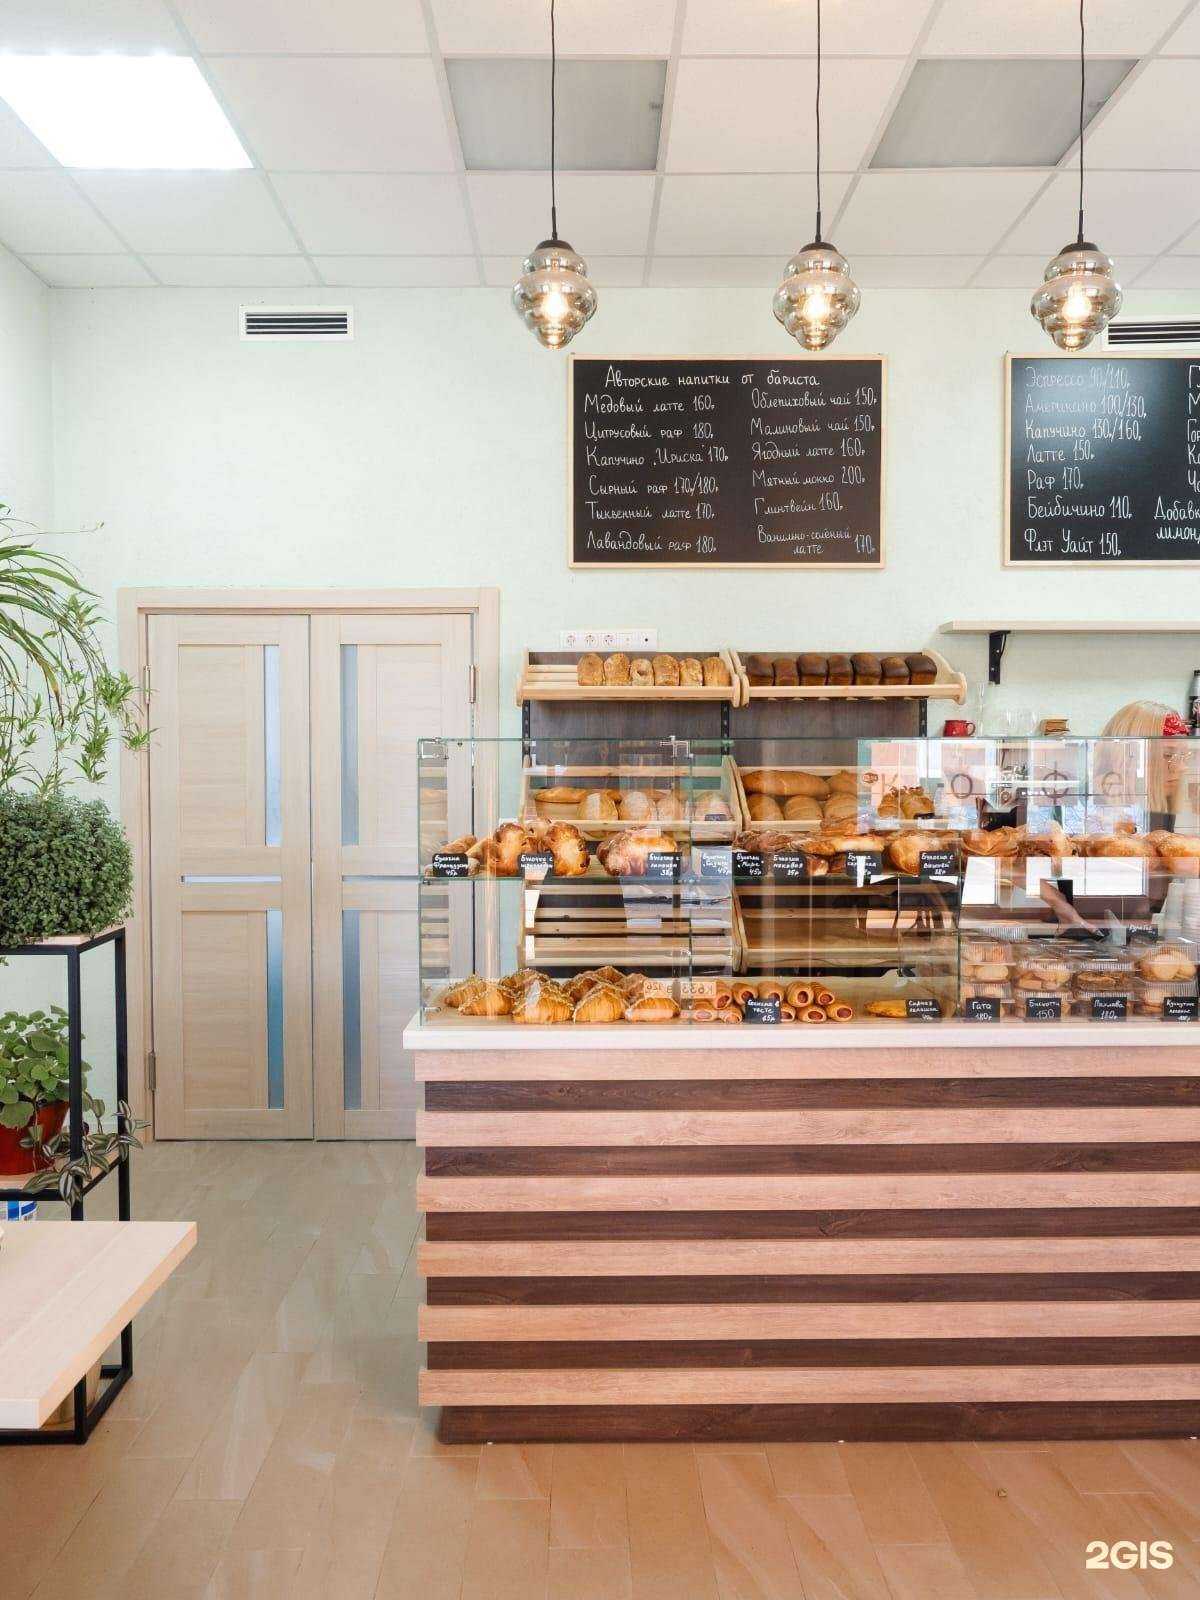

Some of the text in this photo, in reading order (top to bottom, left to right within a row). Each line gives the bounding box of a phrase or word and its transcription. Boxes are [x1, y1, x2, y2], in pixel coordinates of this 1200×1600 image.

[605, 364, 820, 388] Авторские напитки от бариста
[584, 393, 644, 413] Медовый
[653, 402, 685, 412] латте
[752, 388, 826, 409] Облепиховый
[830, 392, 851, 405] чай
[584, 420, 652, 441] Цитрусовый
[660, 430, 683, 439] раф
[750, 417, 821, 435] Малиновый
[828, 418, 849, 431] чай
[1025, 419, 1086, 439] Капучино
[586, 446, 645, 467] Капучино
[752, 442, 800, 461] Ягодный
[806, 448, 835, 457] латте
[1028, 444, 1066, 463] Латте
[589, 474, 639, 496] Сырный
[648, 485, 668, 494] раф
[752, 470, 800, 487] Мятный
[803, 474, 835, 485] мокко
[1028, 470, 1055, 490] Раф
[585, 501, 652, 519] Тыквенный
[662, 510, 692, 519] латте
[754, 498, 816, 515] Глинтвейн
[1028, 495, 1105, 519] Бейбичино
[586, 530, 663, 551] Лавандовый
[668, 543, 692, 551] раф
[793, 545, 824, 555] латте
[1024, 528, 1054, 552] Флэт
[1061, 528, 1093, 554] Уайт
[972, 1002, 992, 1010] Гата
